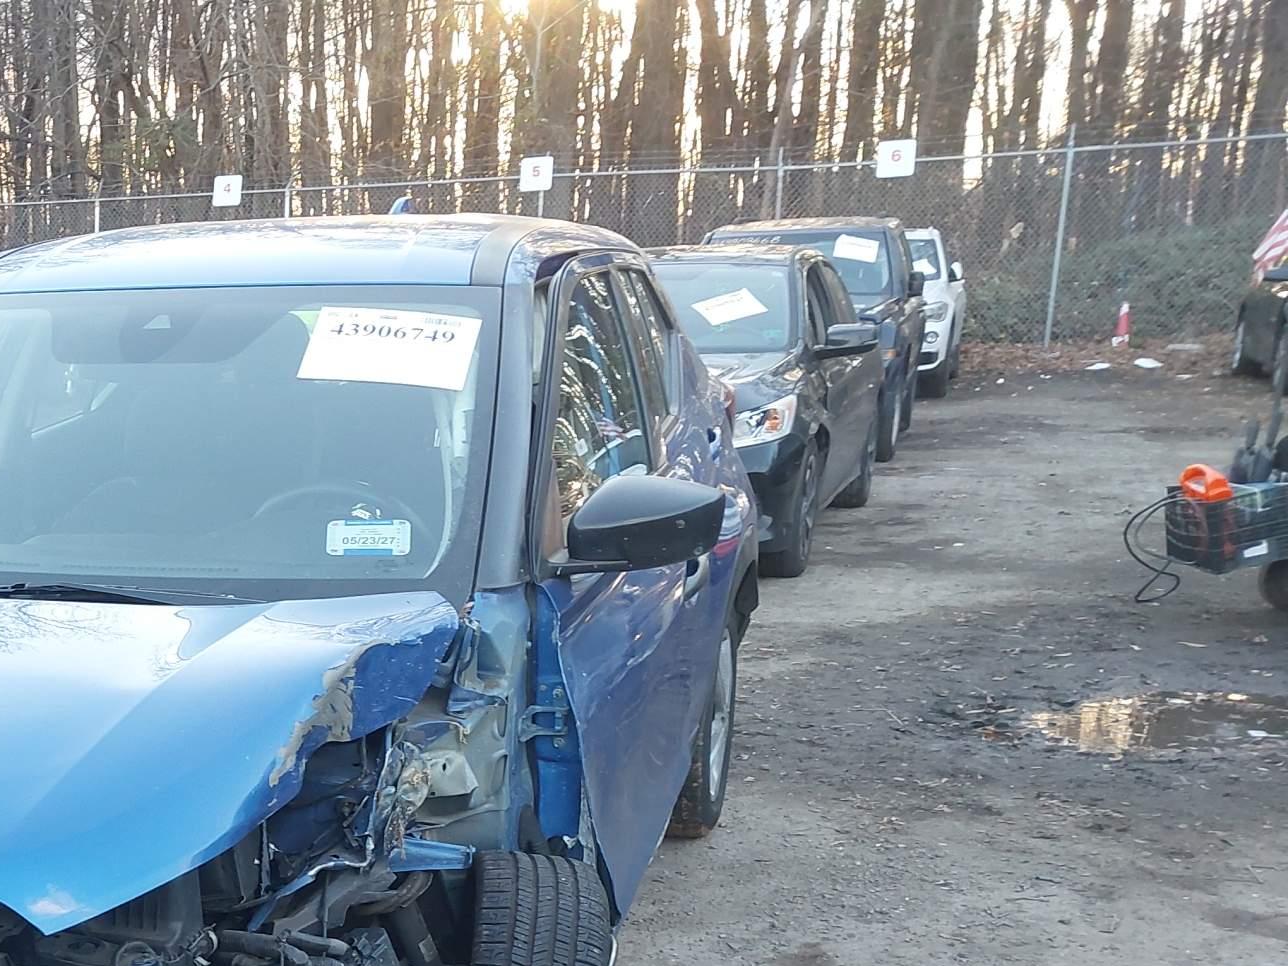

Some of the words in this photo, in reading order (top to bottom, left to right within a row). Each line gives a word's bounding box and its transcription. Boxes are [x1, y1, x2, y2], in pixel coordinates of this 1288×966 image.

[891, 149, 902, 162] 6
[532, 165, 541, 177] 5
[223, 183, 231, 193] 4
[330, 321, 456, 343] 43906749
[341, 536, 397, 545] 05/23/27
